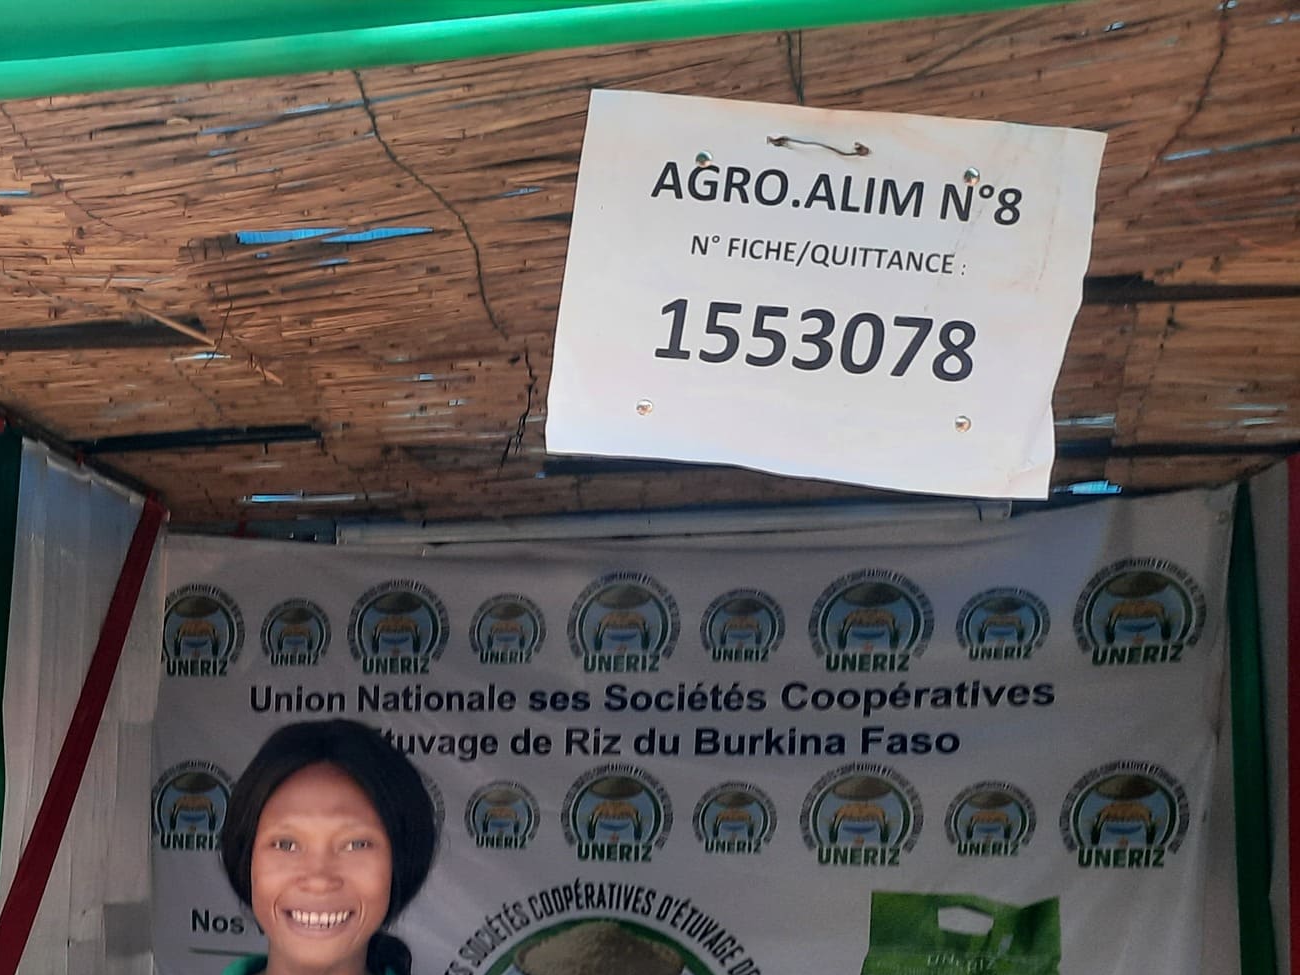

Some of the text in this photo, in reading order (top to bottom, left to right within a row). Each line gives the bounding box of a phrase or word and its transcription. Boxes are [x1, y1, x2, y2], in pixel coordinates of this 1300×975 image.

[651, 161, 1023, 226] AGRO.ALIM N°8
[690, 234, 721, 257] N°
[726, 237, 955, 275] FICHE/QUITTANCE
[654, 298, 977, 383] 1553078
[270, 654, 320, 667] UNERIZ
[479, 650, 532, 665] UNERIZ
[583, 655, 661, 673] UNERIZ
[711, 648, 769, 663] UNERIZ
[824, 654, 910, 673] UNERIZ
[968, 647, 1033, 661] UNERIZ
[1091, 645, 1184, 667] UNERIZ
[166, 655, 228, 677] UNERIZ
[362, 655, 430, 675] UNERIZ
[249, 680, 1055, 717] Union Nationale ses Sociétés Coopératives
[510, 729, 552, 755] de
[564, 728, 621, 755] Riz
[633, 728, 680, 755] du
[694, 728, 846, 756] Burkina
[861, 727, 961, 755] Faso
[475, 835, 528, 849] UNERIZ
[704, 839, 762, 855] UNERIZ
[957, 841, 1019, 857] UNERIZ
[576, 842, 653, 863] UNERIZ
[817, 847, 901, 867] UNERIZ
[1077, 847, 1165, 869] UNERIZ
[191, 909, 245, 934] Nos
